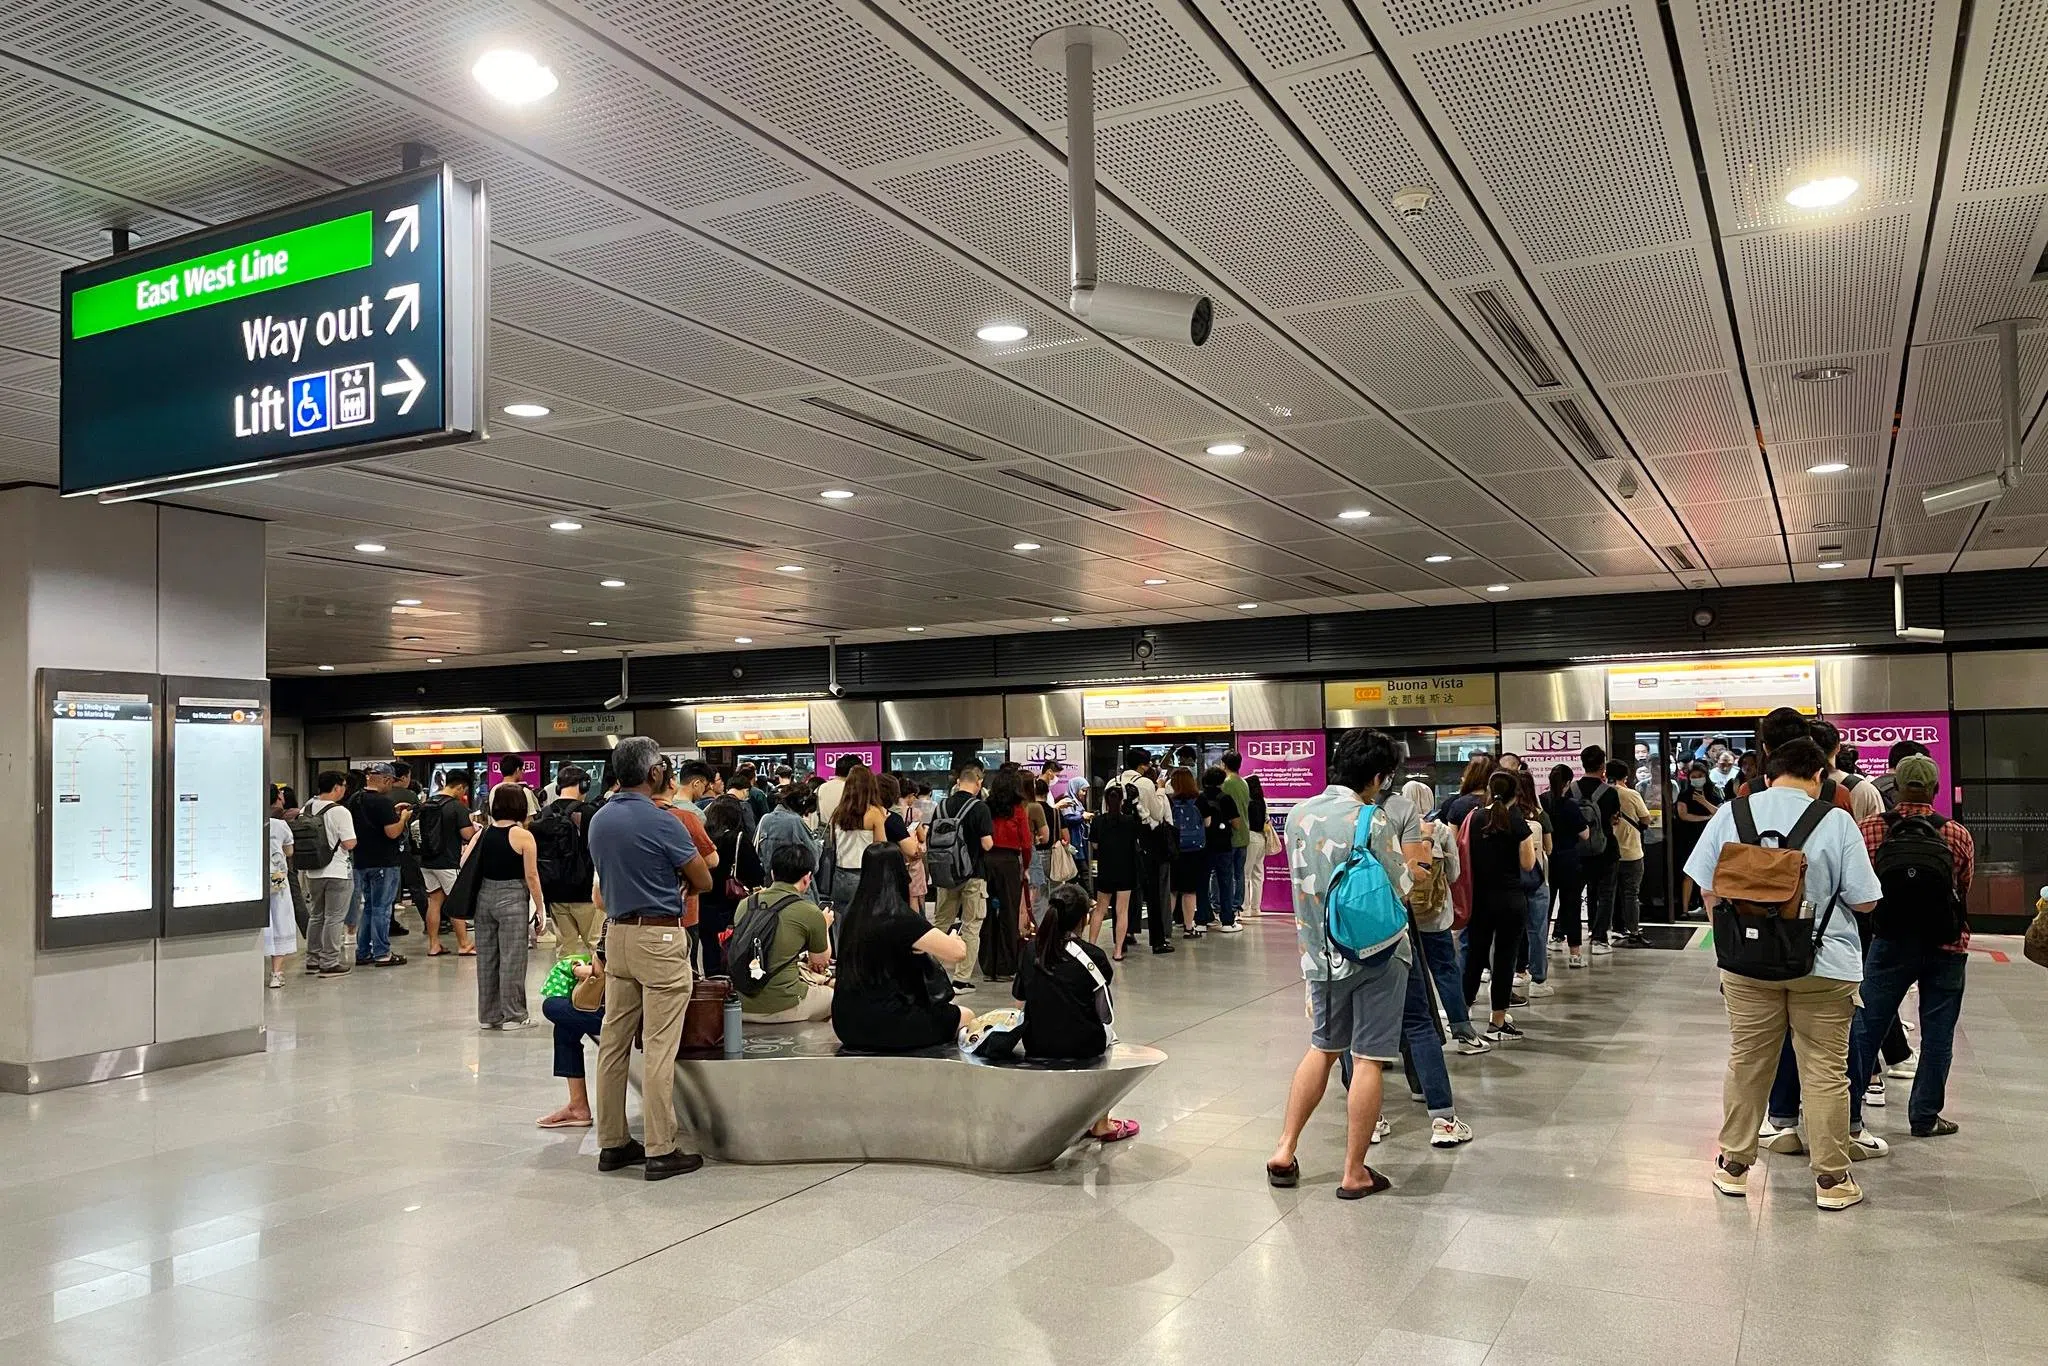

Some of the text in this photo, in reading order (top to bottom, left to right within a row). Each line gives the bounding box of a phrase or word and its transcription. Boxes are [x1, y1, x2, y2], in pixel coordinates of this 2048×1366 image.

[136, 249, 289, 310] East West Line
[241, 295, 374, 363] Way out
[234, 385, 285, 438] Lift
[1355, 688, 1381, 699] CC22
[1387, 678, 1464, 691] Buona Vista
[1249, 742, 1314, 756] DEEPEN
[1525, 730, 1581, 751] RISE
[1026, 743, 1067, 761] RISE
